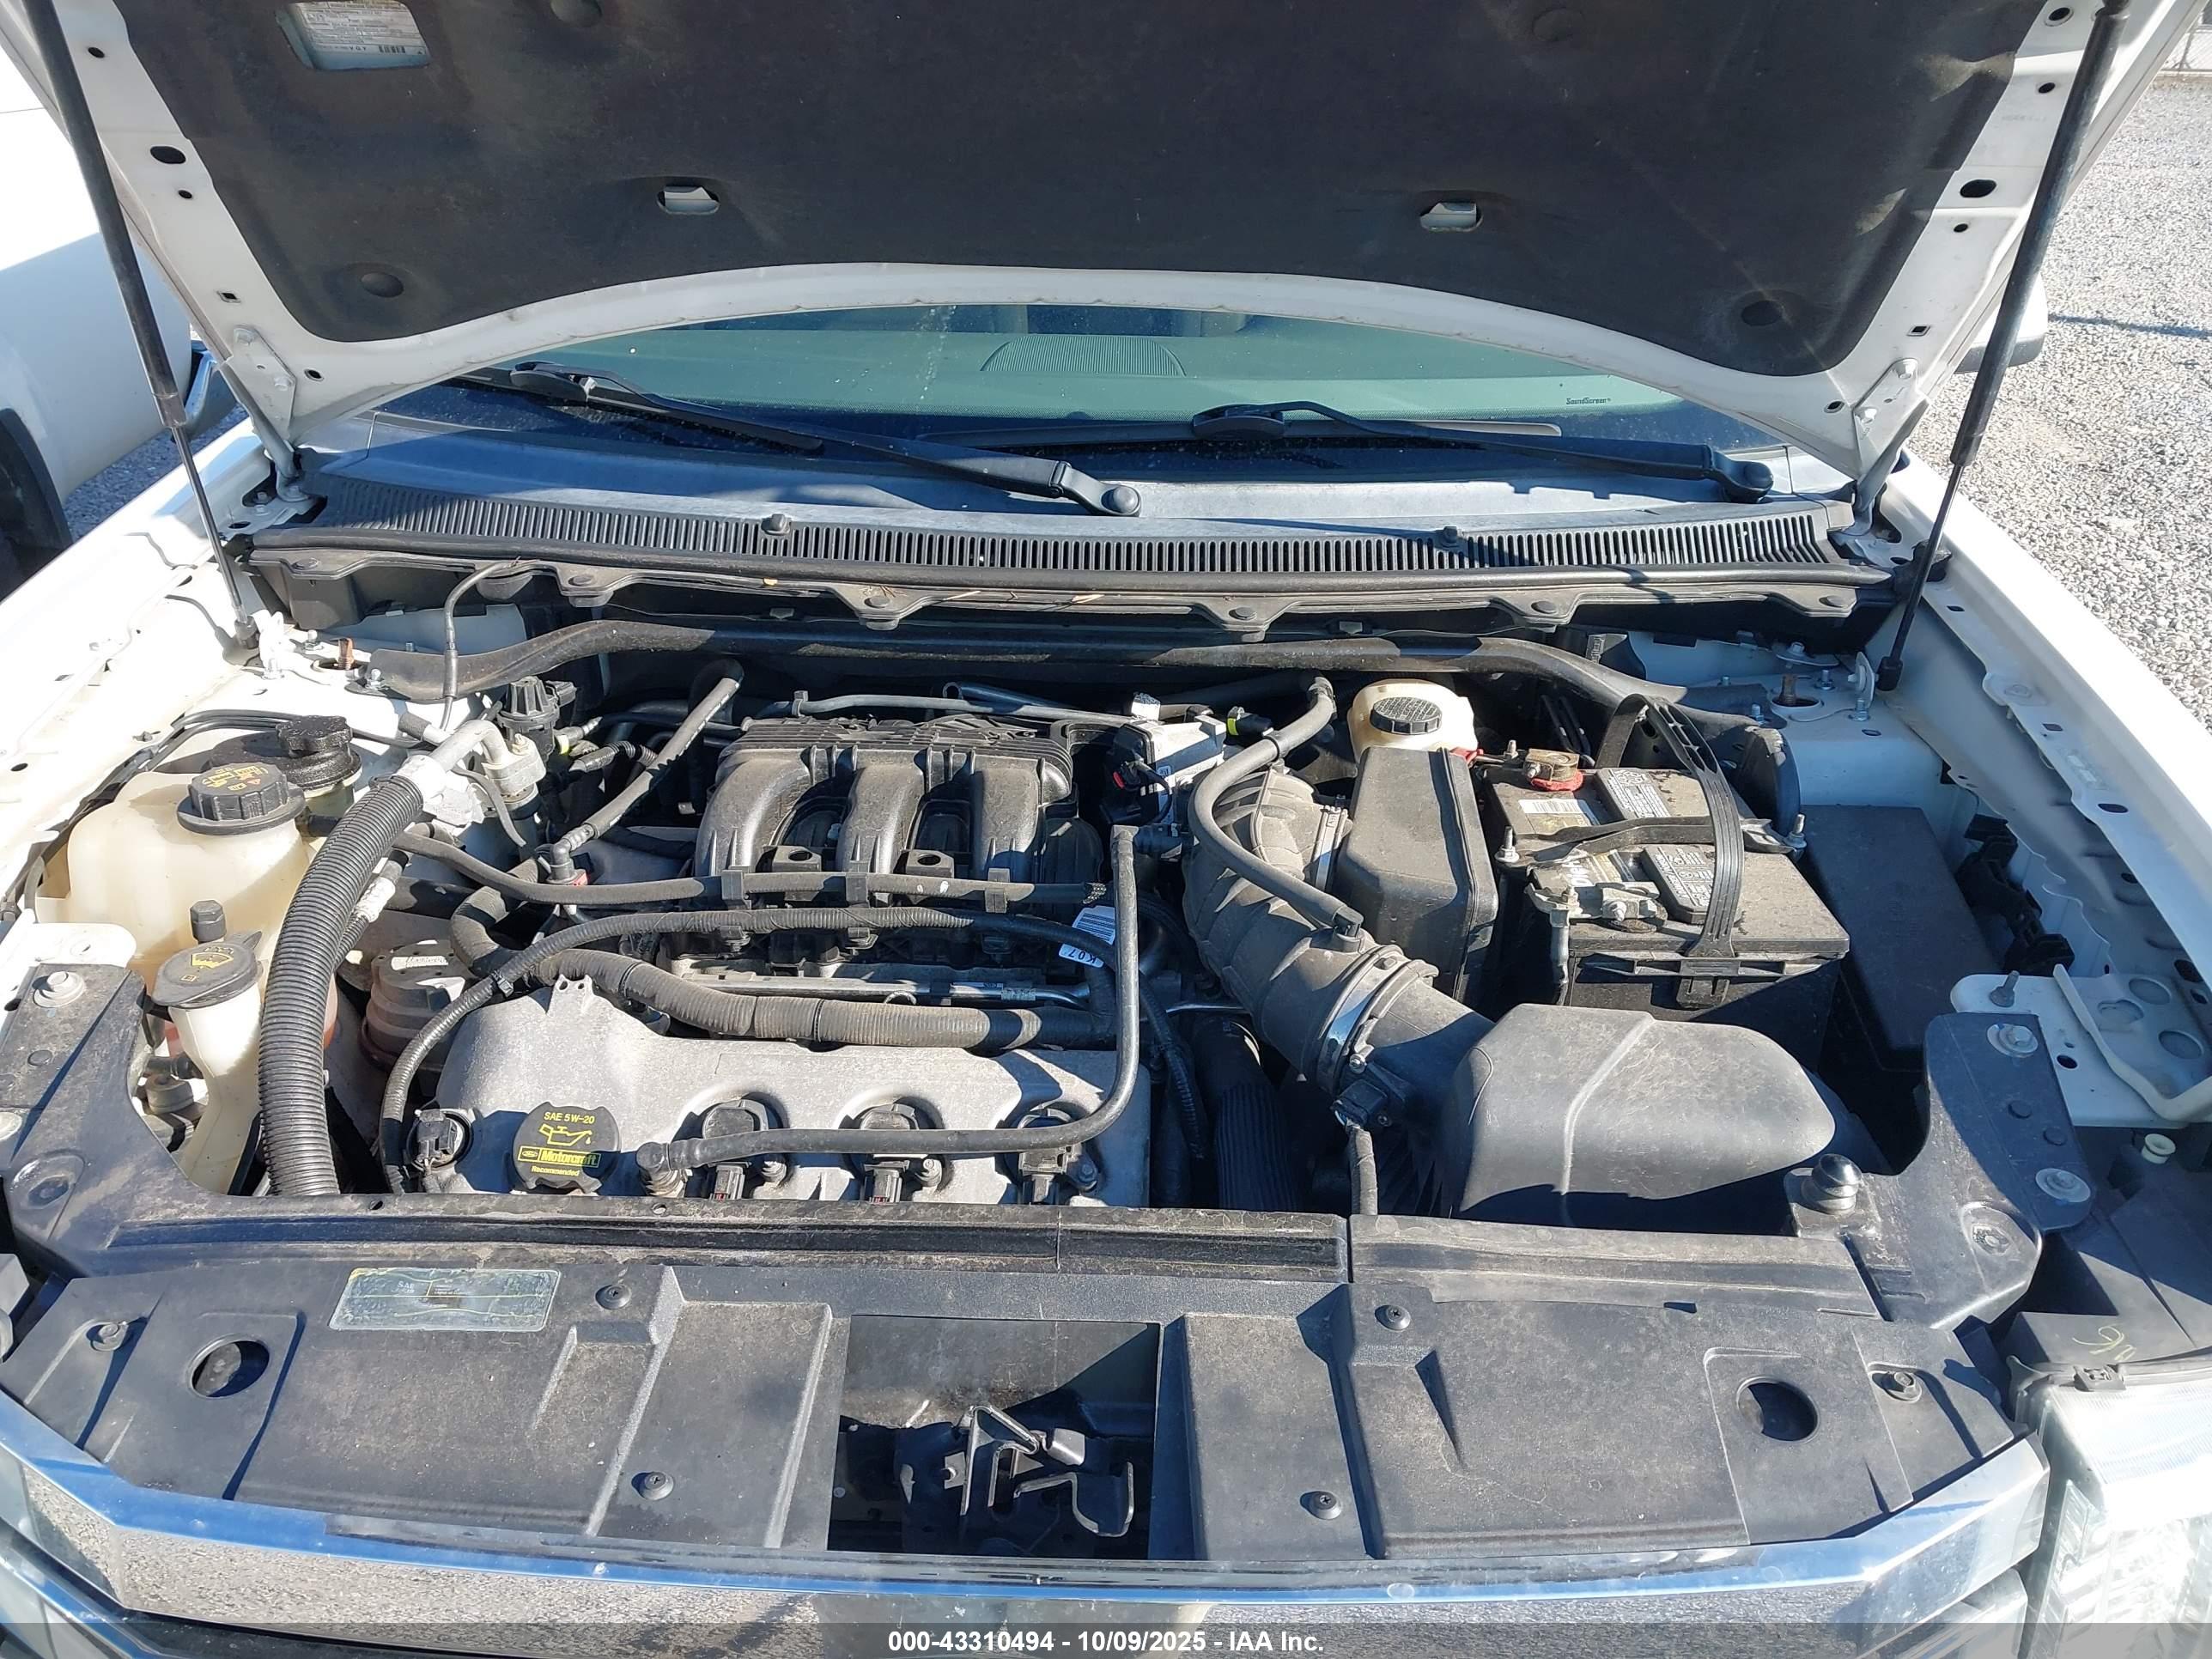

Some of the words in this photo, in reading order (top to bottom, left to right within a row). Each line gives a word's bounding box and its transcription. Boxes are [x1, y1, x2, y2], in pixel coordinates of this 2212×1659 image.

[544, 1111, 563, 1121] SAE
[563, 1113, 595, 1124] 5W-20
[540, 1150, 598, 1165] Motorcraft
[531, 1165, 580, 1176] Recommended
